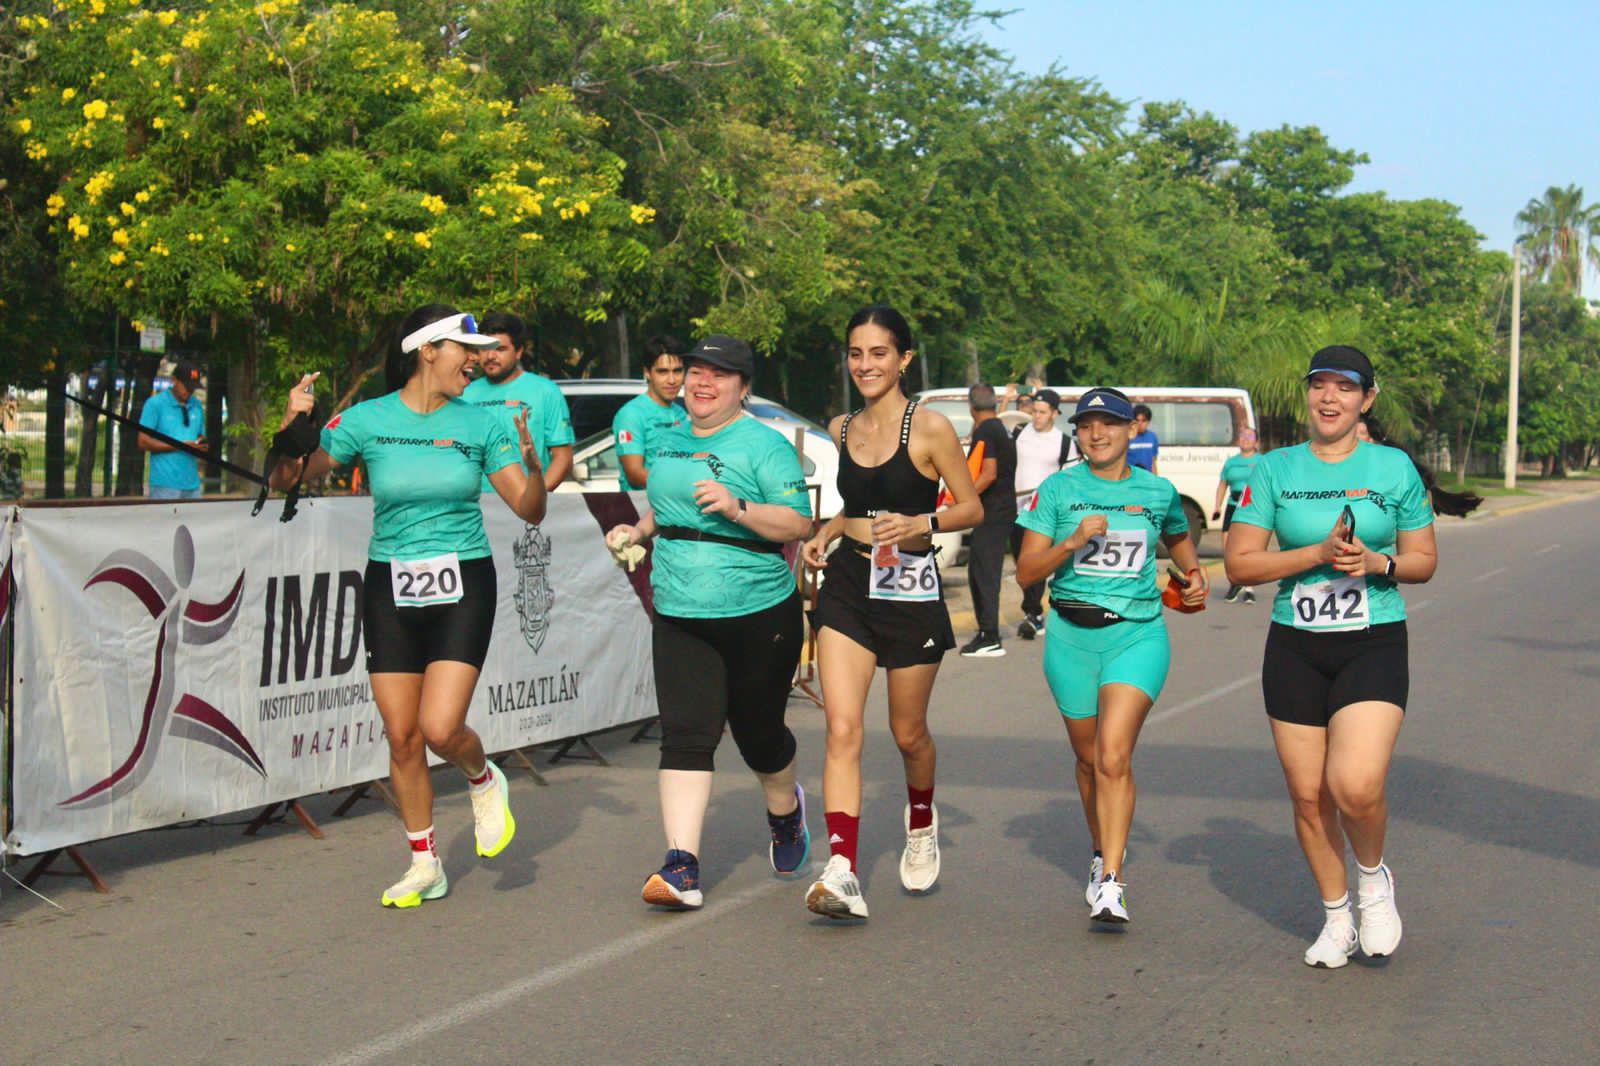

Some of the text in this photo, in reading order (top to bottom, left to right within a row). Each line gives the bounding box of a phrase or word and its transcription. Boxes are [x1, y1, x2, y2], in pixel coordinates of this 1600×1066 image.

[1079, 540, 1144, 568] 257
[396, 567, 457, 598] 220
[876, 564, 936, 593] 256
[1296, 588, 1364, 623] 042
[260, 570, 368, 687] IMD
[259, 683, 369, 722] INSTITUTO MUNICIPAL
[488, 664, 581, 715] MAZATLÁN
